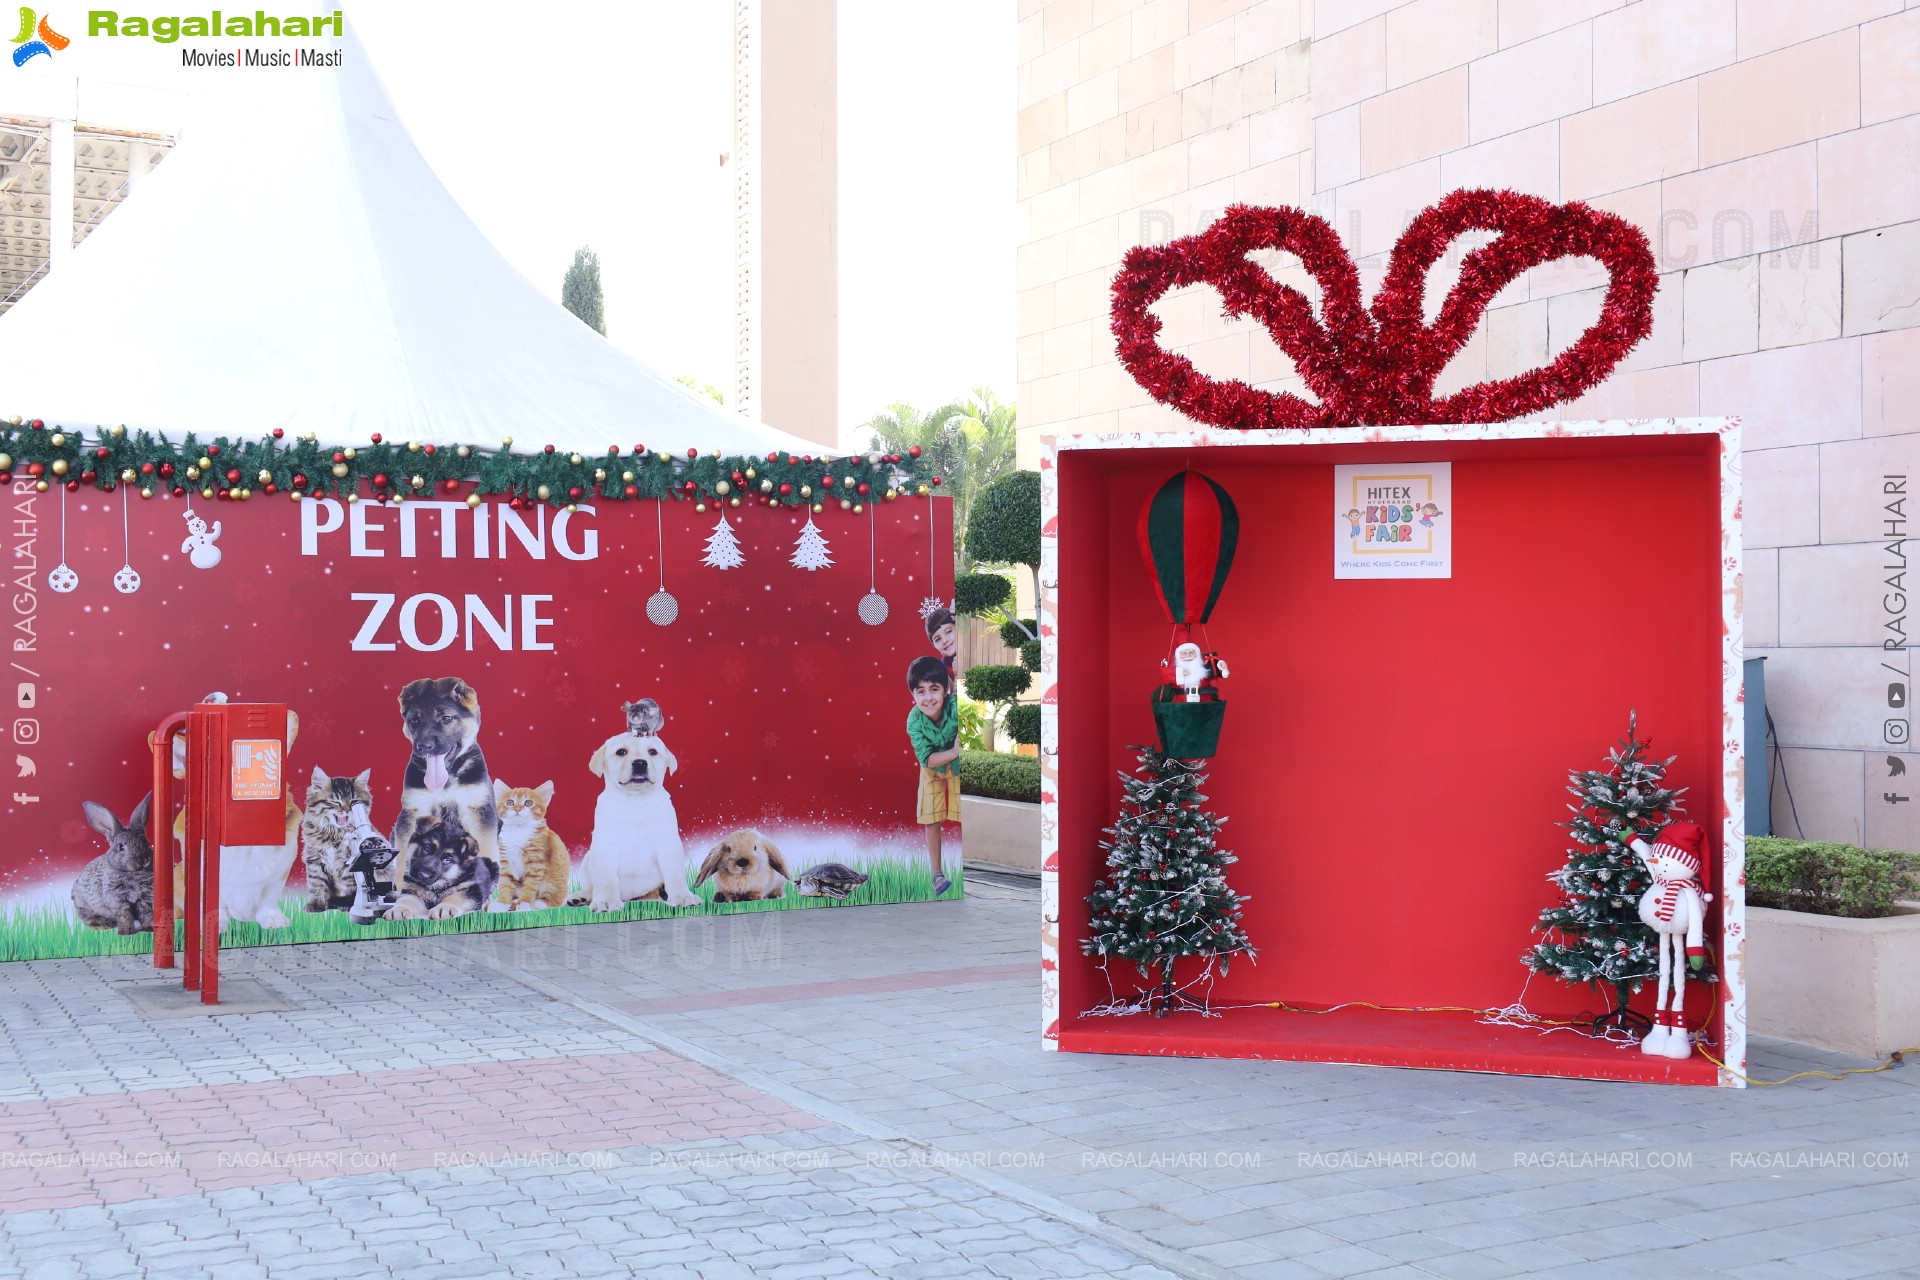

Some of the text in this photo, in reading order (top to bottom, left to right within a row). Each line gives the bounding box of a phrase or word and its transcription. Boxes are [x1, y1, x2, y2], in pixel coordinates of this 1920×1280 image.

[1368, 487, 1411, 499] HITEX
[301, 497, 599, 561] PETTING
[350, 593, 554, 652] ZONE
